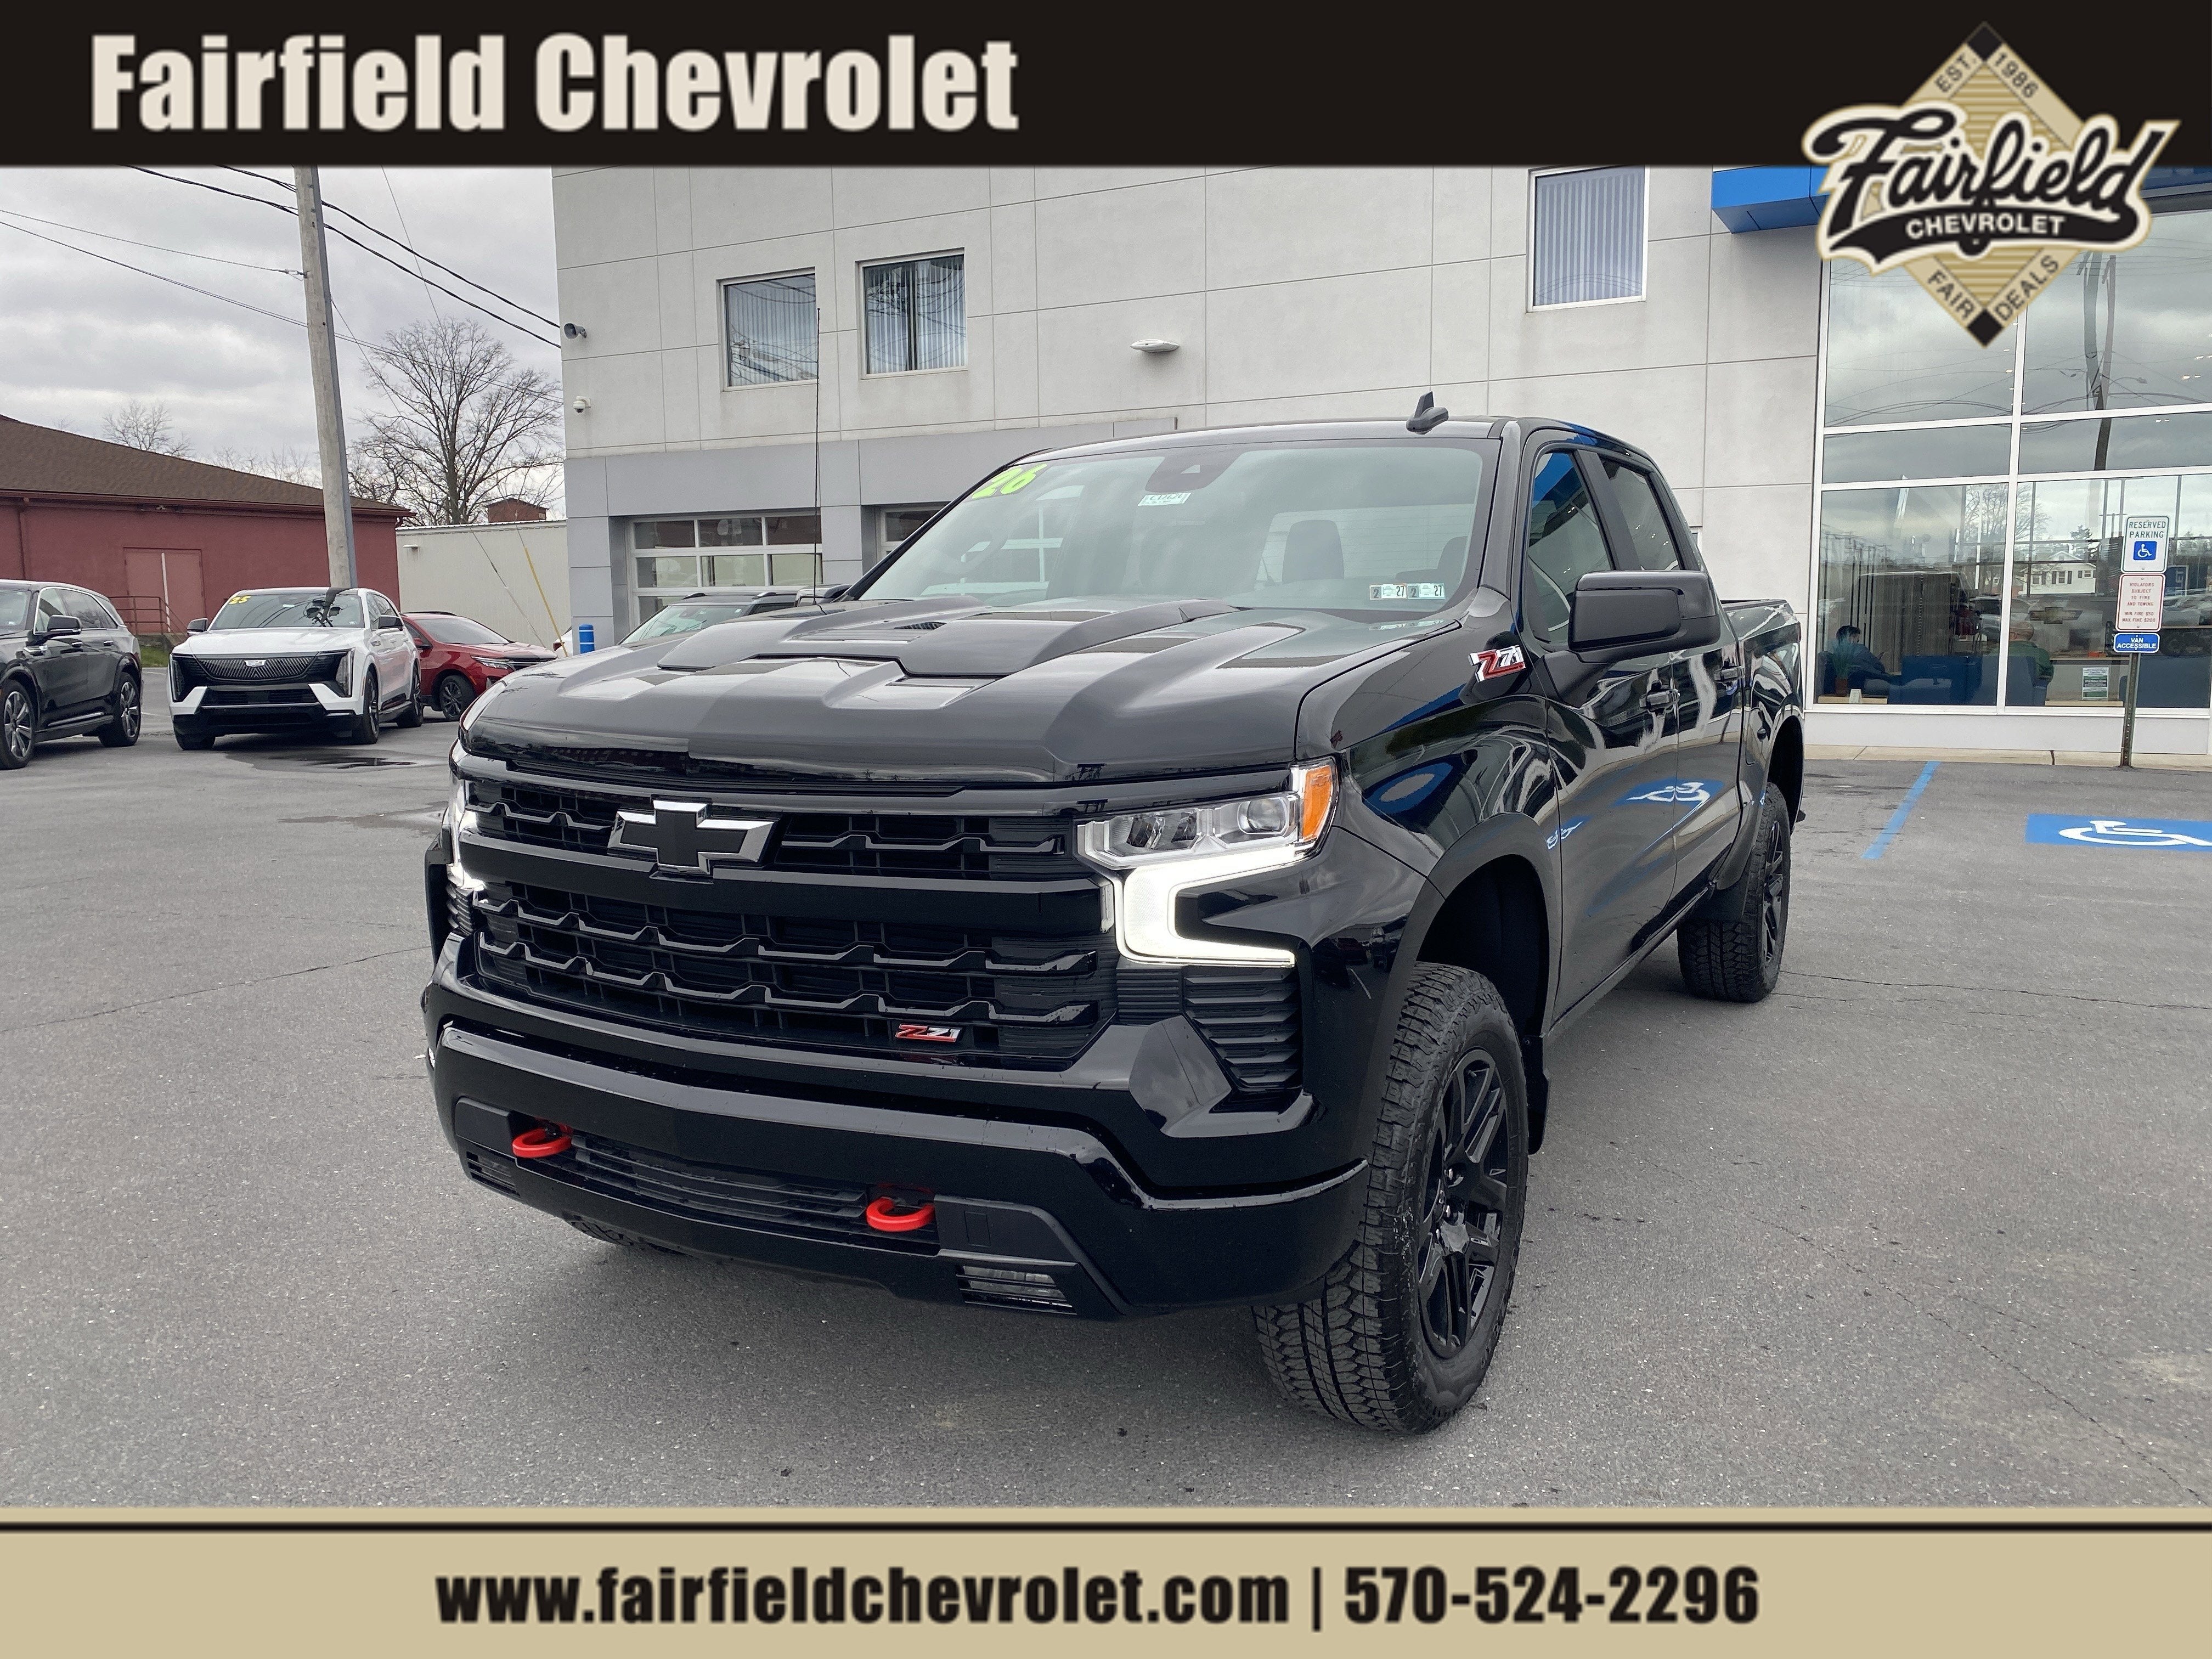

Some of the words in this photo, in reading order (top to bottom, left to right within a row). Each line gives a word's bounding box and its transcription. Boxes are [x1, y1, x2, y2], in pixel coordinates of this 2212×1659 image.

[972, 464, 1047, 499] 26
[1374, 589, 1380, 599] 2
[1396, 585, 1404, 597] 27
[1411, 588, 1417, 598] 2
[1434, 585, 1442, 596] 27
[1468, 644, 1526, 683] Z71
[895, 1024, 962, 1042] Z71
